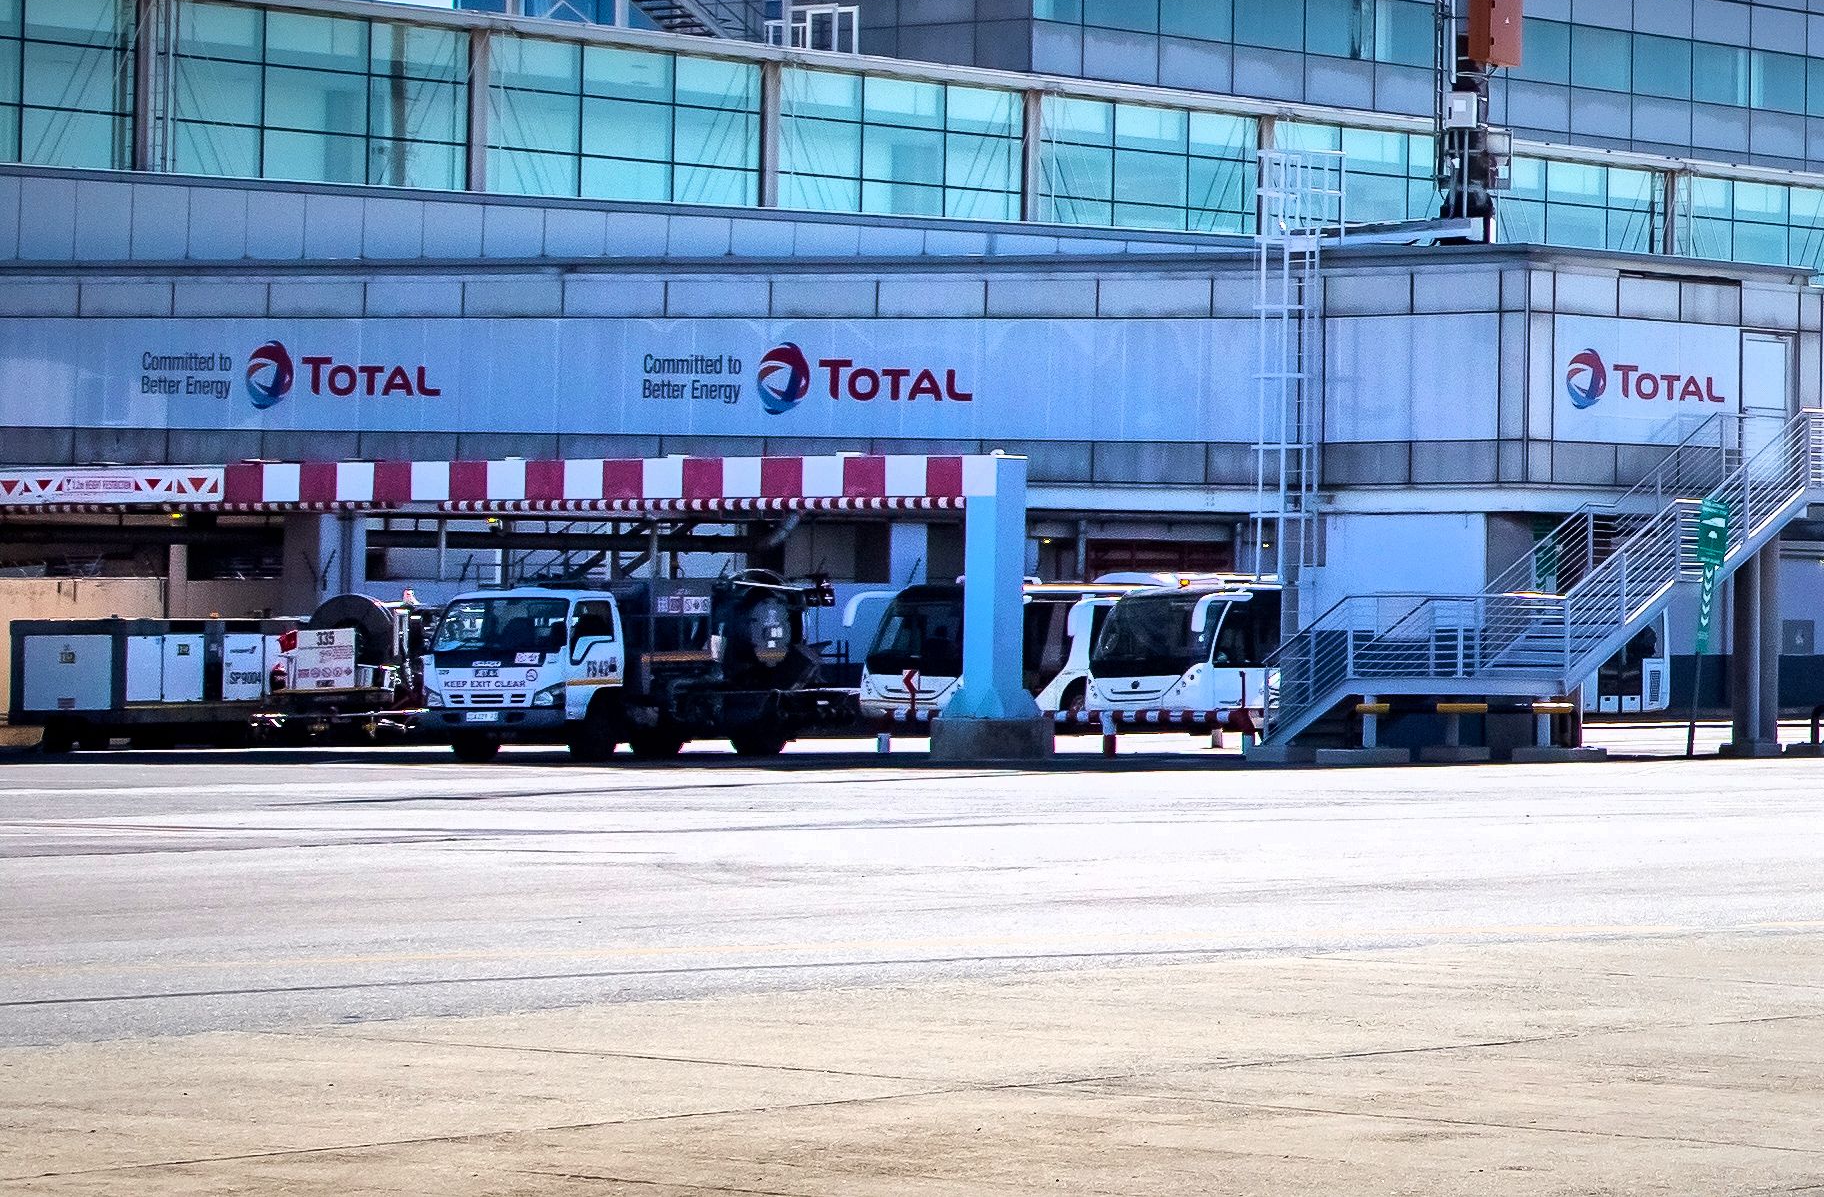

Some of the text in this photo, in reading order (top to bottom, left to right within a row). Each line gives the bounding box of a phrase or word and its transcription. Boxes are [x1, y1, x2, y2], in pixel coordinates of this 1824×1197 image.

[141, 351, 232, 373] Committed to
[643, 353, 742, 376] Committed to
[141, 376, 231, 399] Better Energy
[301, 356, 442, 397] TOTAL
[818, 358, 973, 402] TOTAL
[1612, 363, 1726, 403] TOTAL
[643, 379, 741, 404] Better Energy
[316, 631, 335, 645] 335
